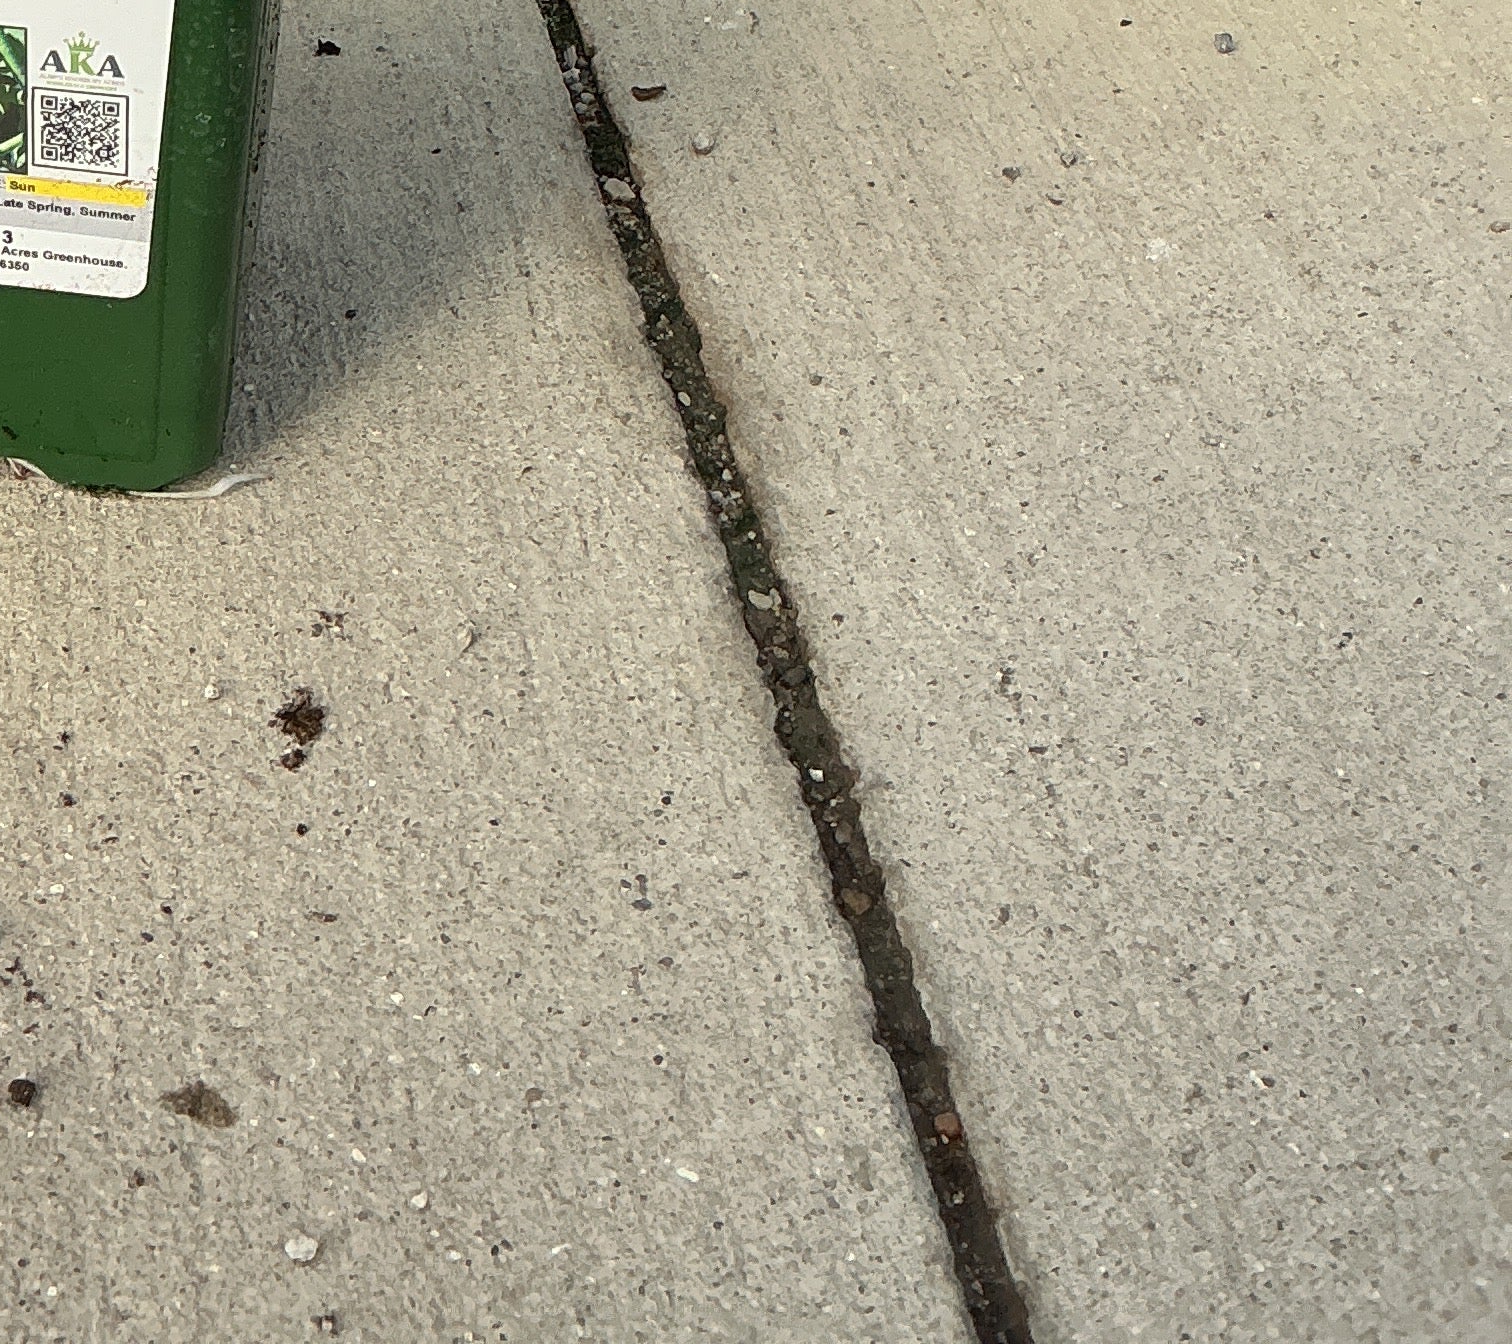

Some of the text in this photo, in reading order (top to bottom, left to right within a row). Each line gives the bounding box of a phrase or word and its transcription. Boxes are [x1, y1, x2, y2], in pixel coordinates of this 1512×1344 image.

[39, 50, 125, 79] AKA
[9, 180, 36, 193] Sun
[79, 207, 137, 222] Summer
[1, 246, 38, 259] Acres
